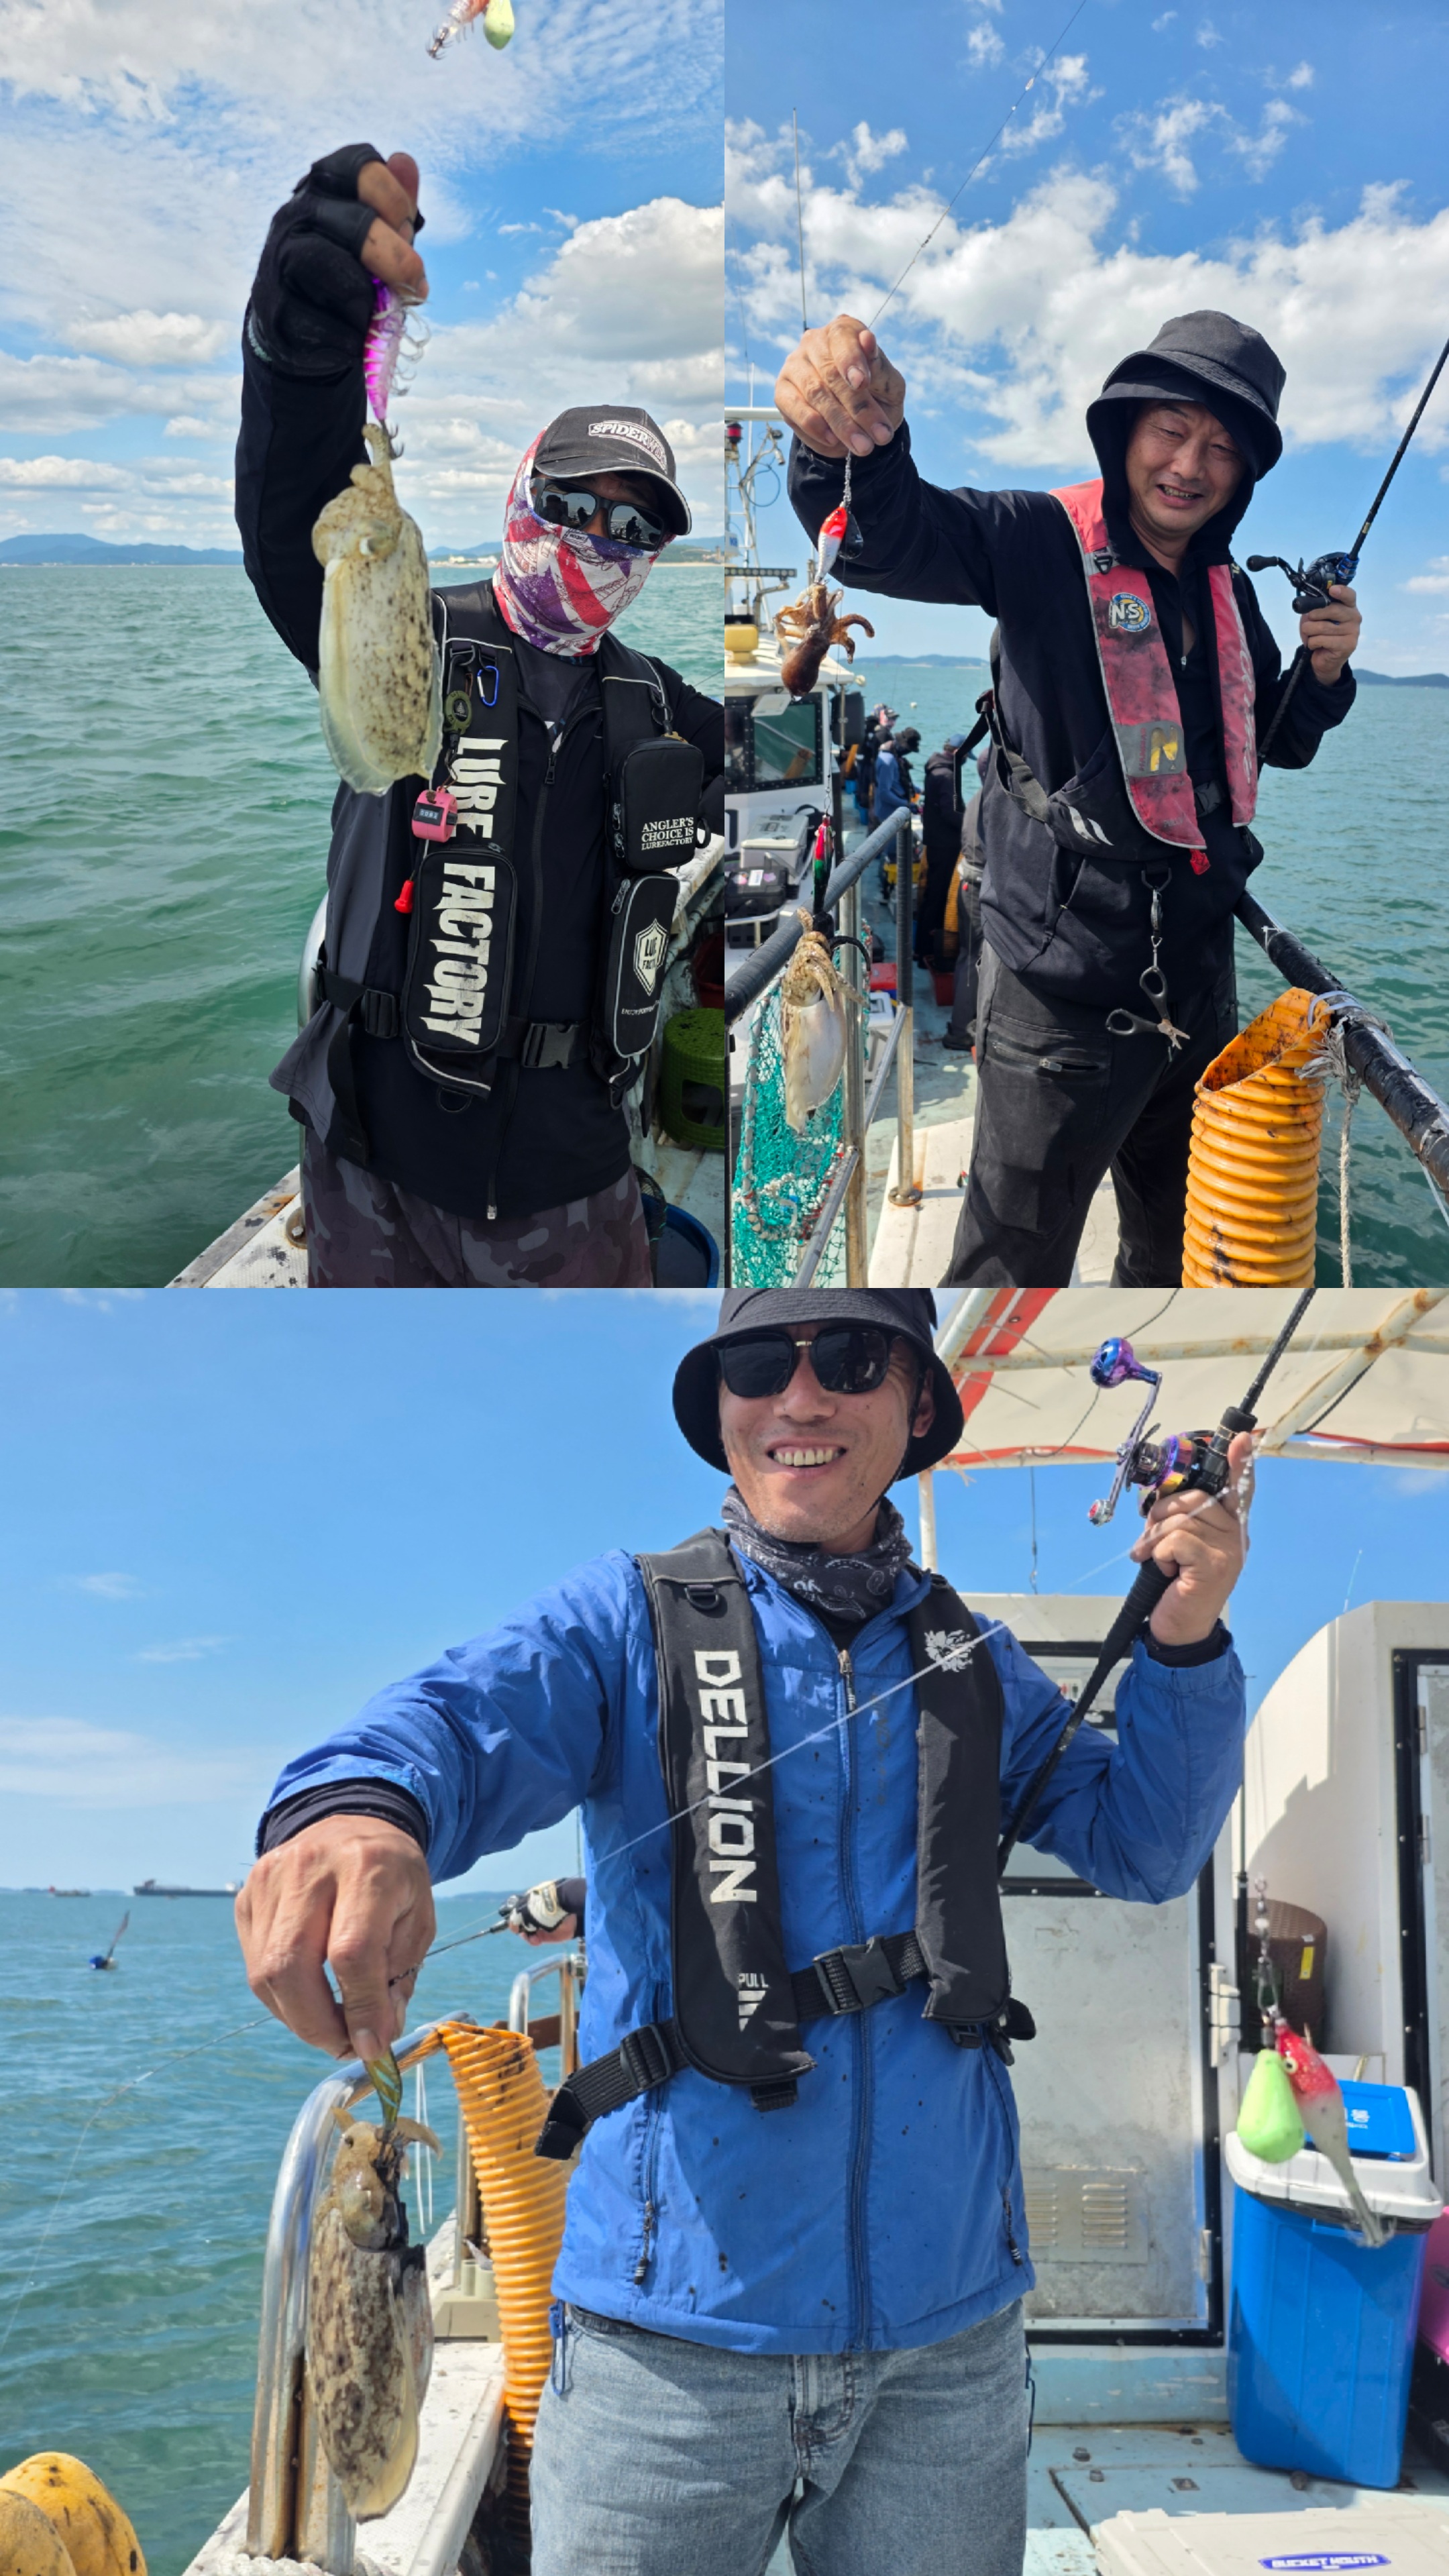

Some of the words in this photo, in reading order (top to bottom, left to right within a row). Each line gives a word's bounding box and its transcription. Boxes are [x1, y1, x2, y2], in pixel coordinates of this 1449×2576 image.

[591, 423, 667, 467] SPIDERW
[443, 737, 508, 839] LURE
[642, 817, 694, 832] ANGLER'S
[641, 829, 683, 842] CHOICE
[685, 827, 694, 836] IS
[641, 837, 694, 851] LUREFACTORY
[419, 862, 496, 1045] FACTORY
[694, 1650, 757, 1903] DELLION
[739, 1973, 769, 1988] PULL
[1272, 2558, 1328, 2569] BUCKET
[1330, 2556, 1379, 2565] MOUTH
